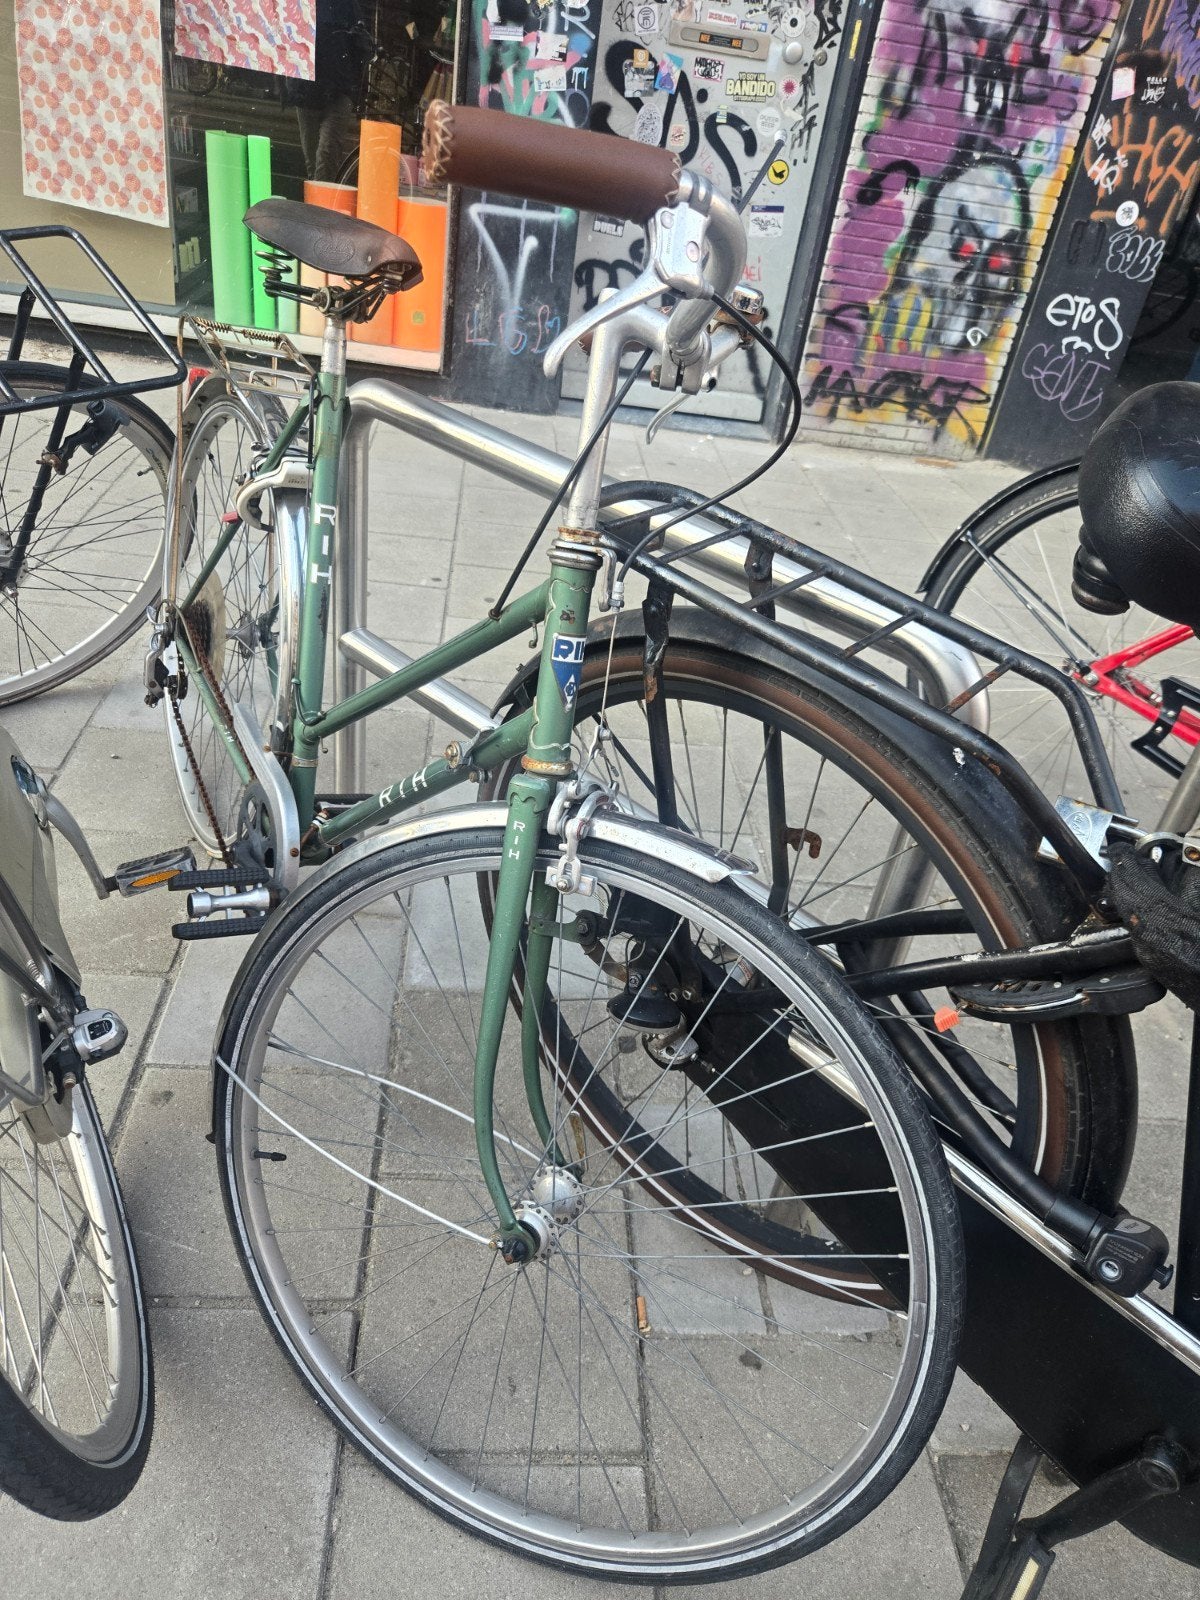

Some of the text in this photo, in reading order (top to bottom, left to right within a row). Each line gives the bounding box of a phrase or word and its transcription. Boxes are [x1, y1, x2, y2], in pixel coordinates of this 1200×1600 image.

[726, 79, 776, 97] BANDIDO
[747, 72, 757, 80] SOY
[310, 502, 336, 585] RIH
[379, 765, 428, 808] RIH
[508, 820, 526, 860] RIH
